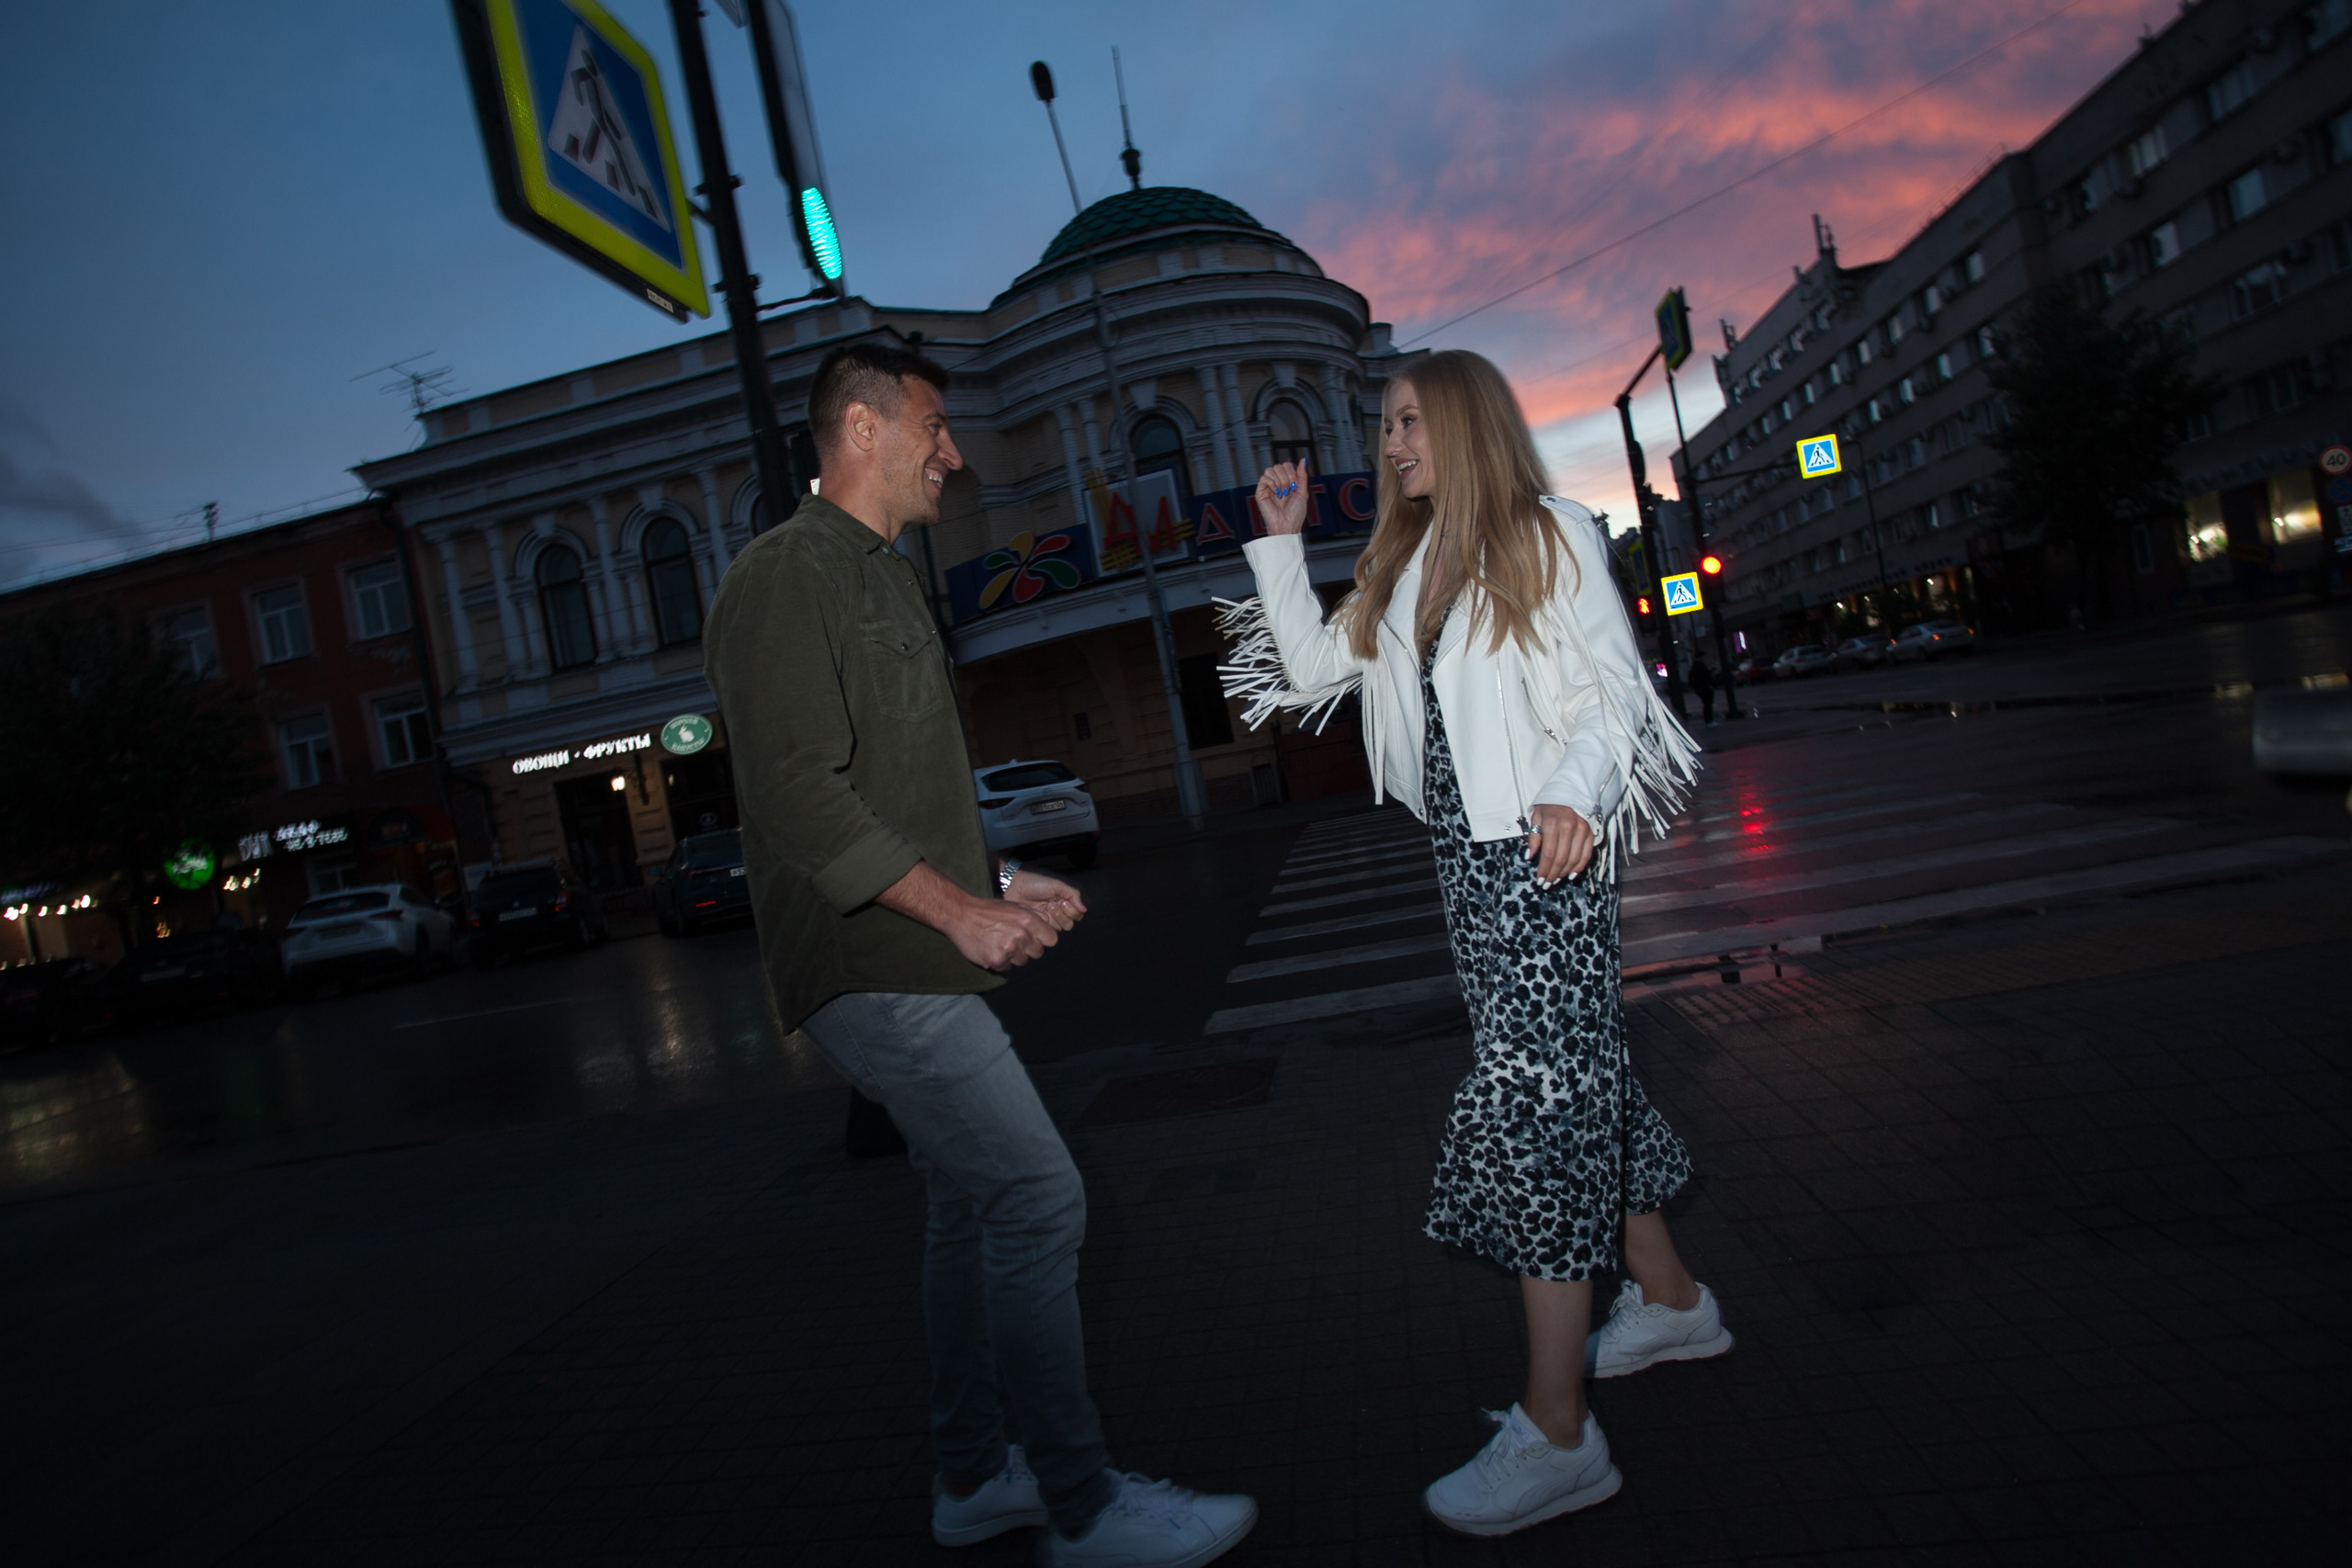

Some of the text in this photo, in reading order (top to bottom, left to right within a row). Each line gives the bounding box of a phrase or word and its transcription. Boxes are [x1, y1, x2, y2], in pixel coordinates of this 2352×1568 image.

[2326, 453, 2346, 466] 40
[513, 750, 570, 774] ОВОЩИ
[582, 733, 651, 760] ФРУКТЫ
